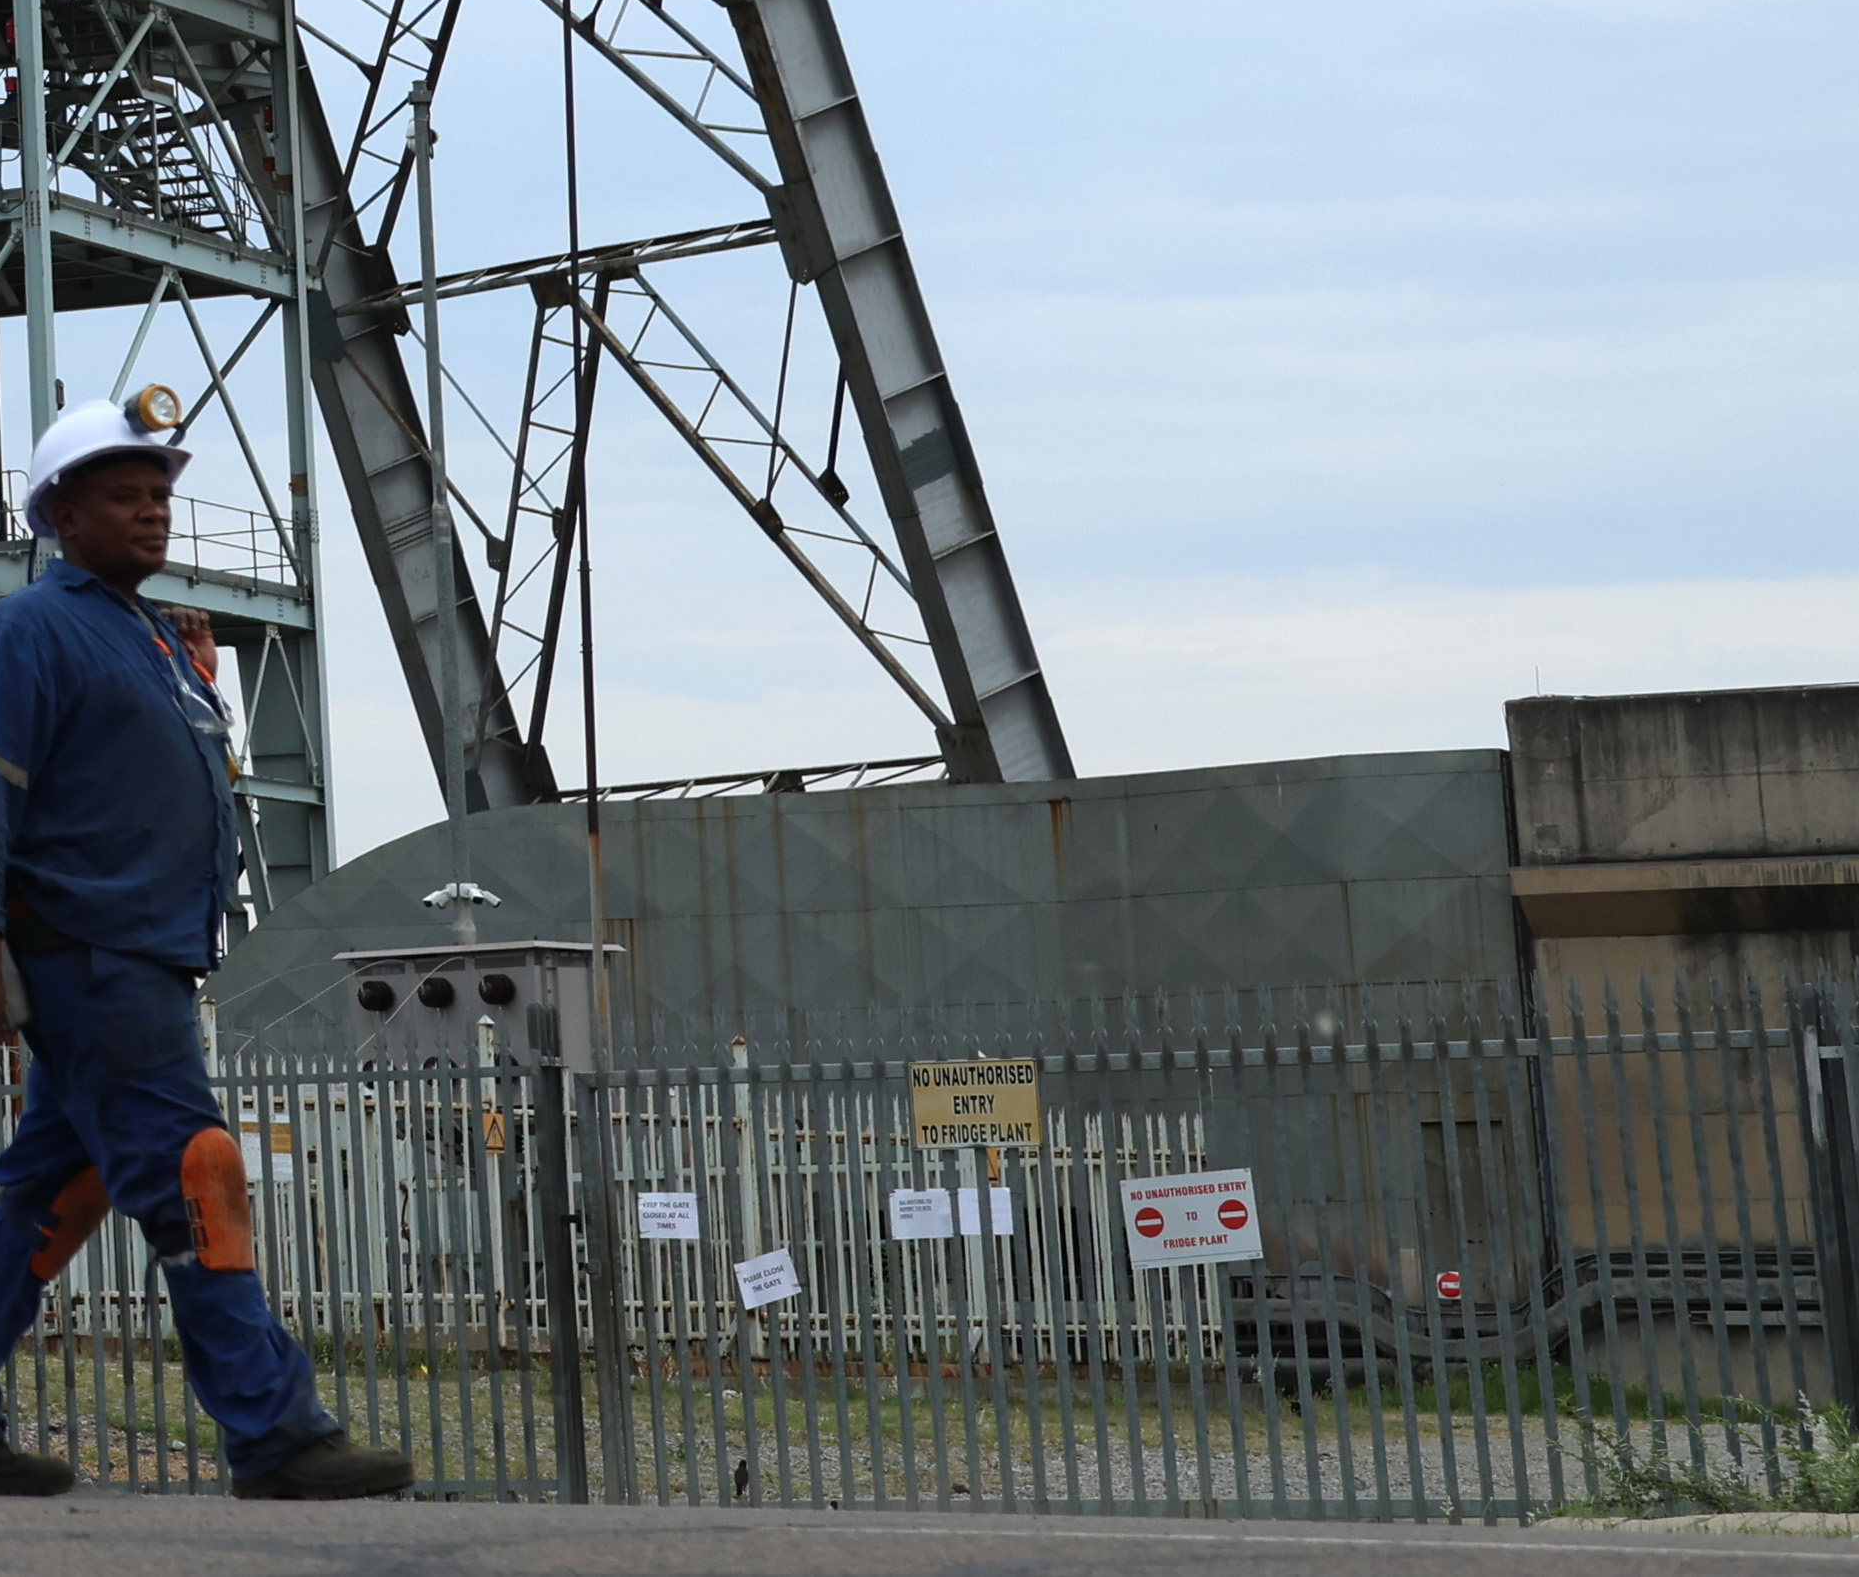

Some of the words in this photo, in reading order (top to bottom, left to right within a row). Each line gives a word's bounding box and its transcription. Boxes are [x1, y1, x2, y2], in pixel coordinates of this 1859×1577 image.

[912, 1068, 930, 1087] NO
[933, 1065, 1034, 1087] UNAUTHORISED
[953, 1095, 995, 1115] ENTRY
[922, 1125, 939, 1144] TO
[942, 1124, 988, 1144] FRIDGE
[990, 1122, 1033, 1142] PLANT
[1130, 1191, 1143, 1201] NO
[1145, 1184, 1216, 1200] UNAUTHORISED
[1218, 1181, 1247, 1193] ENTRY
[1185, 1211, 1198, 1221] TO
[1163, 1237, 1196, 1249] FRIDGE
[1199, 1234, 1229, 1246] PLANT
[743, 1270, 764, 1284] PLEASE
[763, 1264, 785, 1277] CLOSE
[752, 1283, 764, 1293] THE
[764, 1277, 782, 1289] GATE
